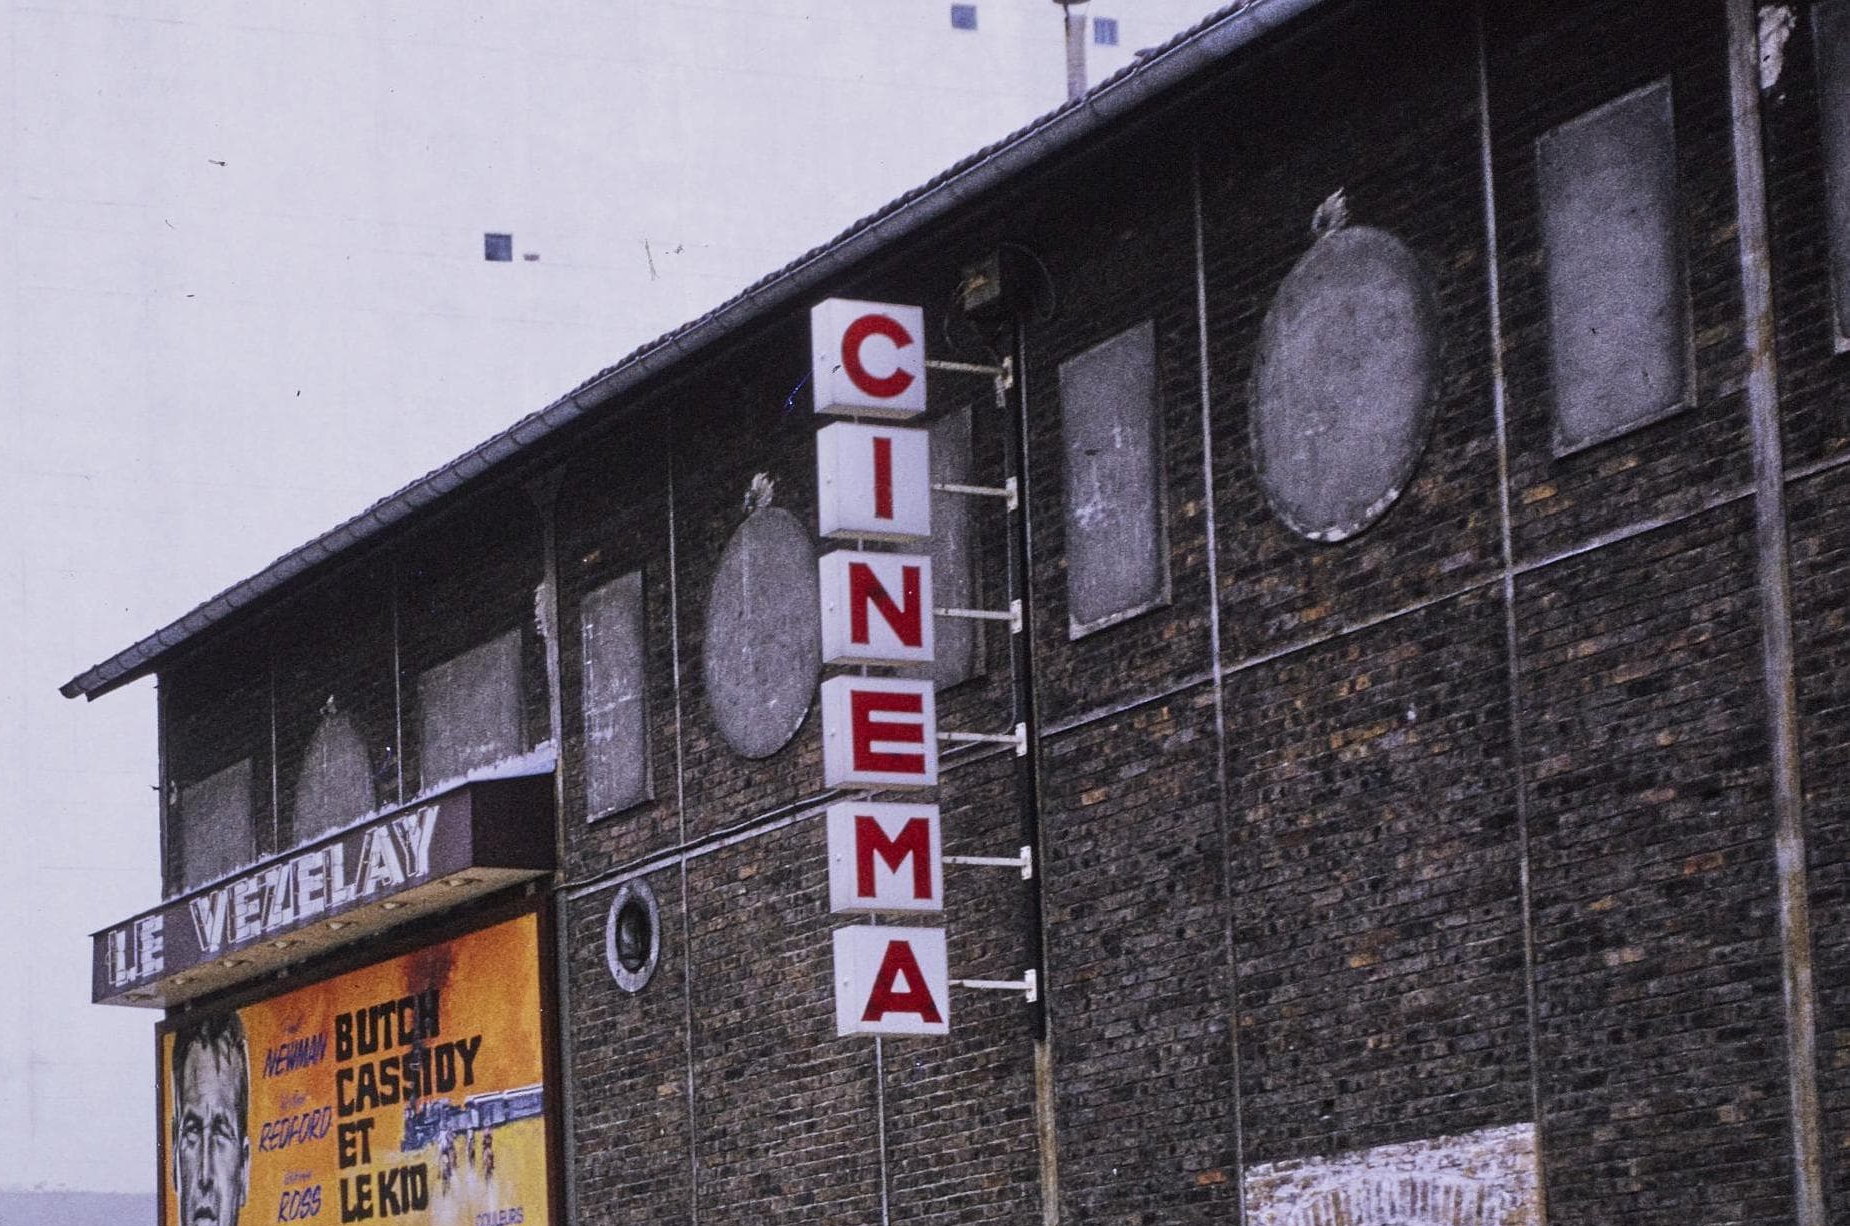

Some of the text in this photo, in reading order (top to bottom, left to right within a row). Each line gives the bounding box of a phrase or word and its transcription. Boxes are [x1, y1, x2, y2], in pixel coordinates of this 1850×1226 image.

[840, 313, 944, 1024] CINEMA
[107, 805, 440, 988] LE VEZELAY
[262, 1032, 328, 1079] NEWMAN
[335, 989, 440, 1062] BUTCH
[336, 1034, 483, 1117] CASSIDY
[258, 1105, 332, 1153] REDFORD
[338, 1116, 375, 1169] ET
[277, 1184, 322, 1223] ROSS
[339, 1162, 430, 1223] LE KID
